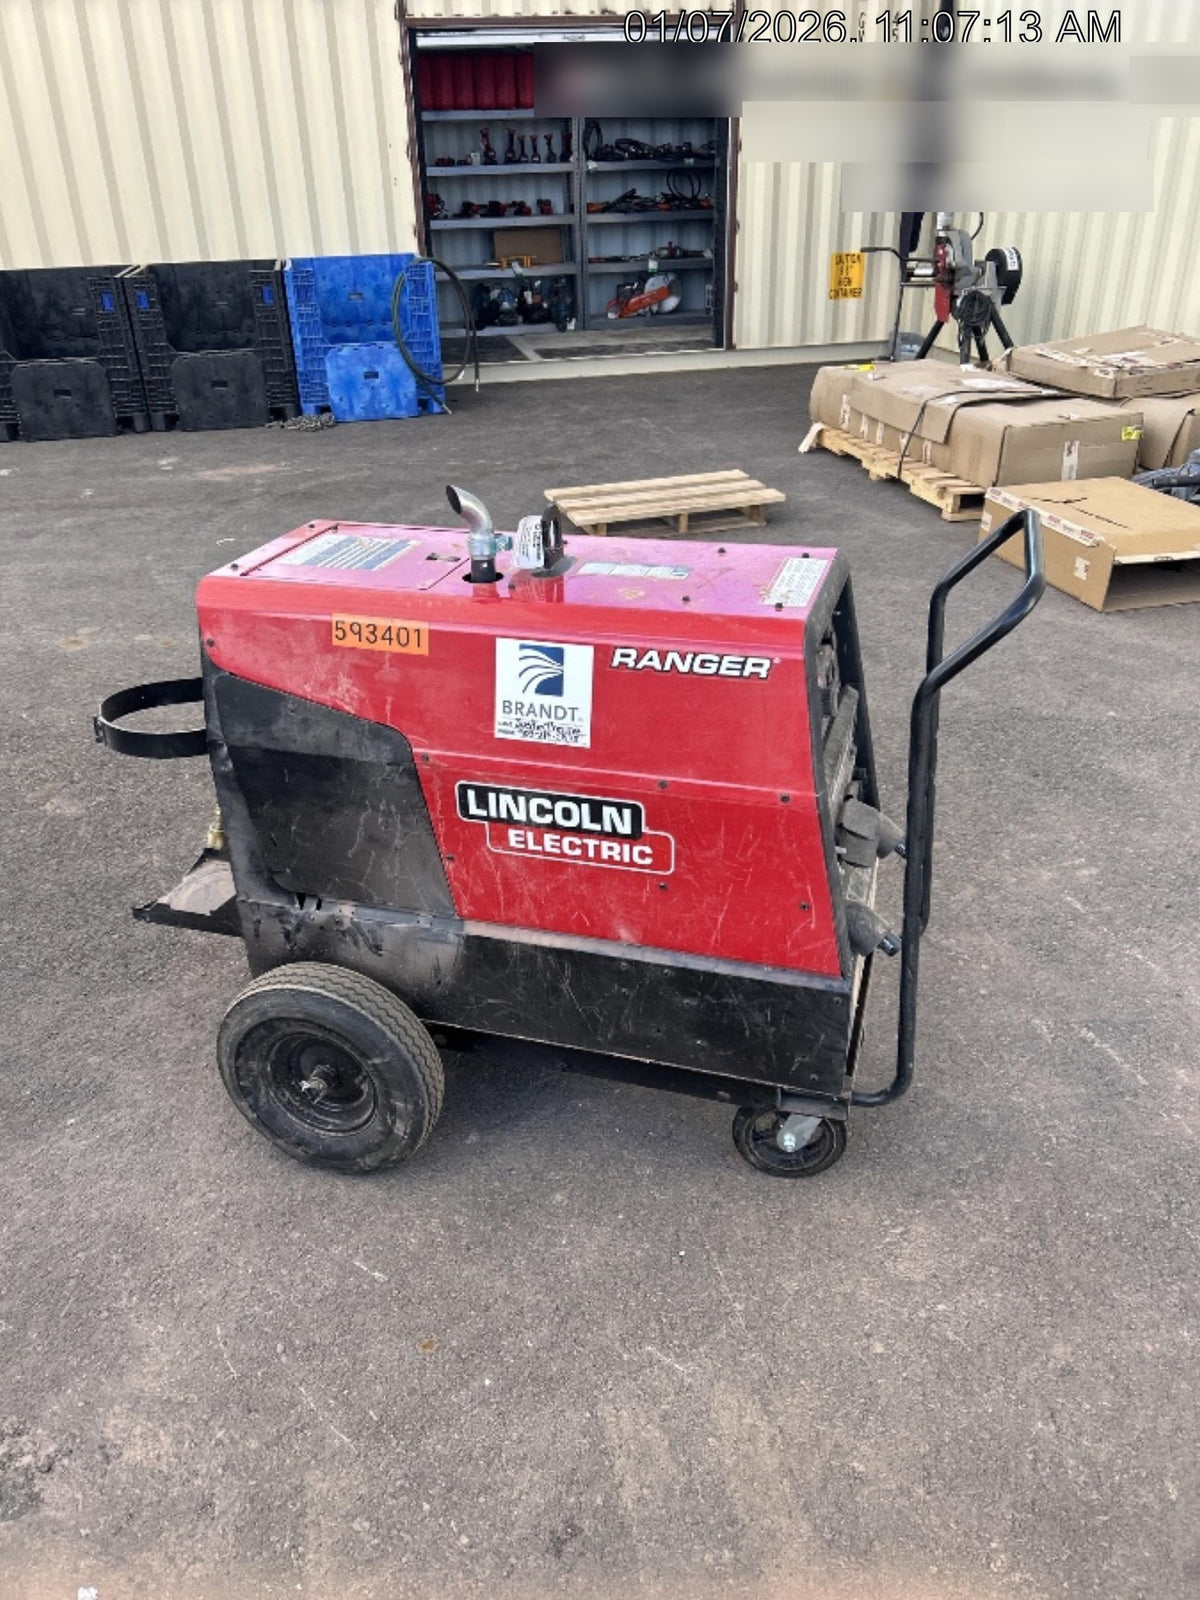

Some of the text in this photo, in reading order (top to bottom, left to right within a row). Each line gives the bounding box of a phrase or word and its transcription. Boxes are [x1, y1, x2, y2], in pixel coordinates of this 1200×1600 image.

[334, 618, 423, 651] 593401
[611, 647, 773, 679] RANGER
[502, 700, 579, 722] BRANDT
[466, 788, 633, 834] LINCOLN
[507, 829, 653, 866] ELECTRIC
